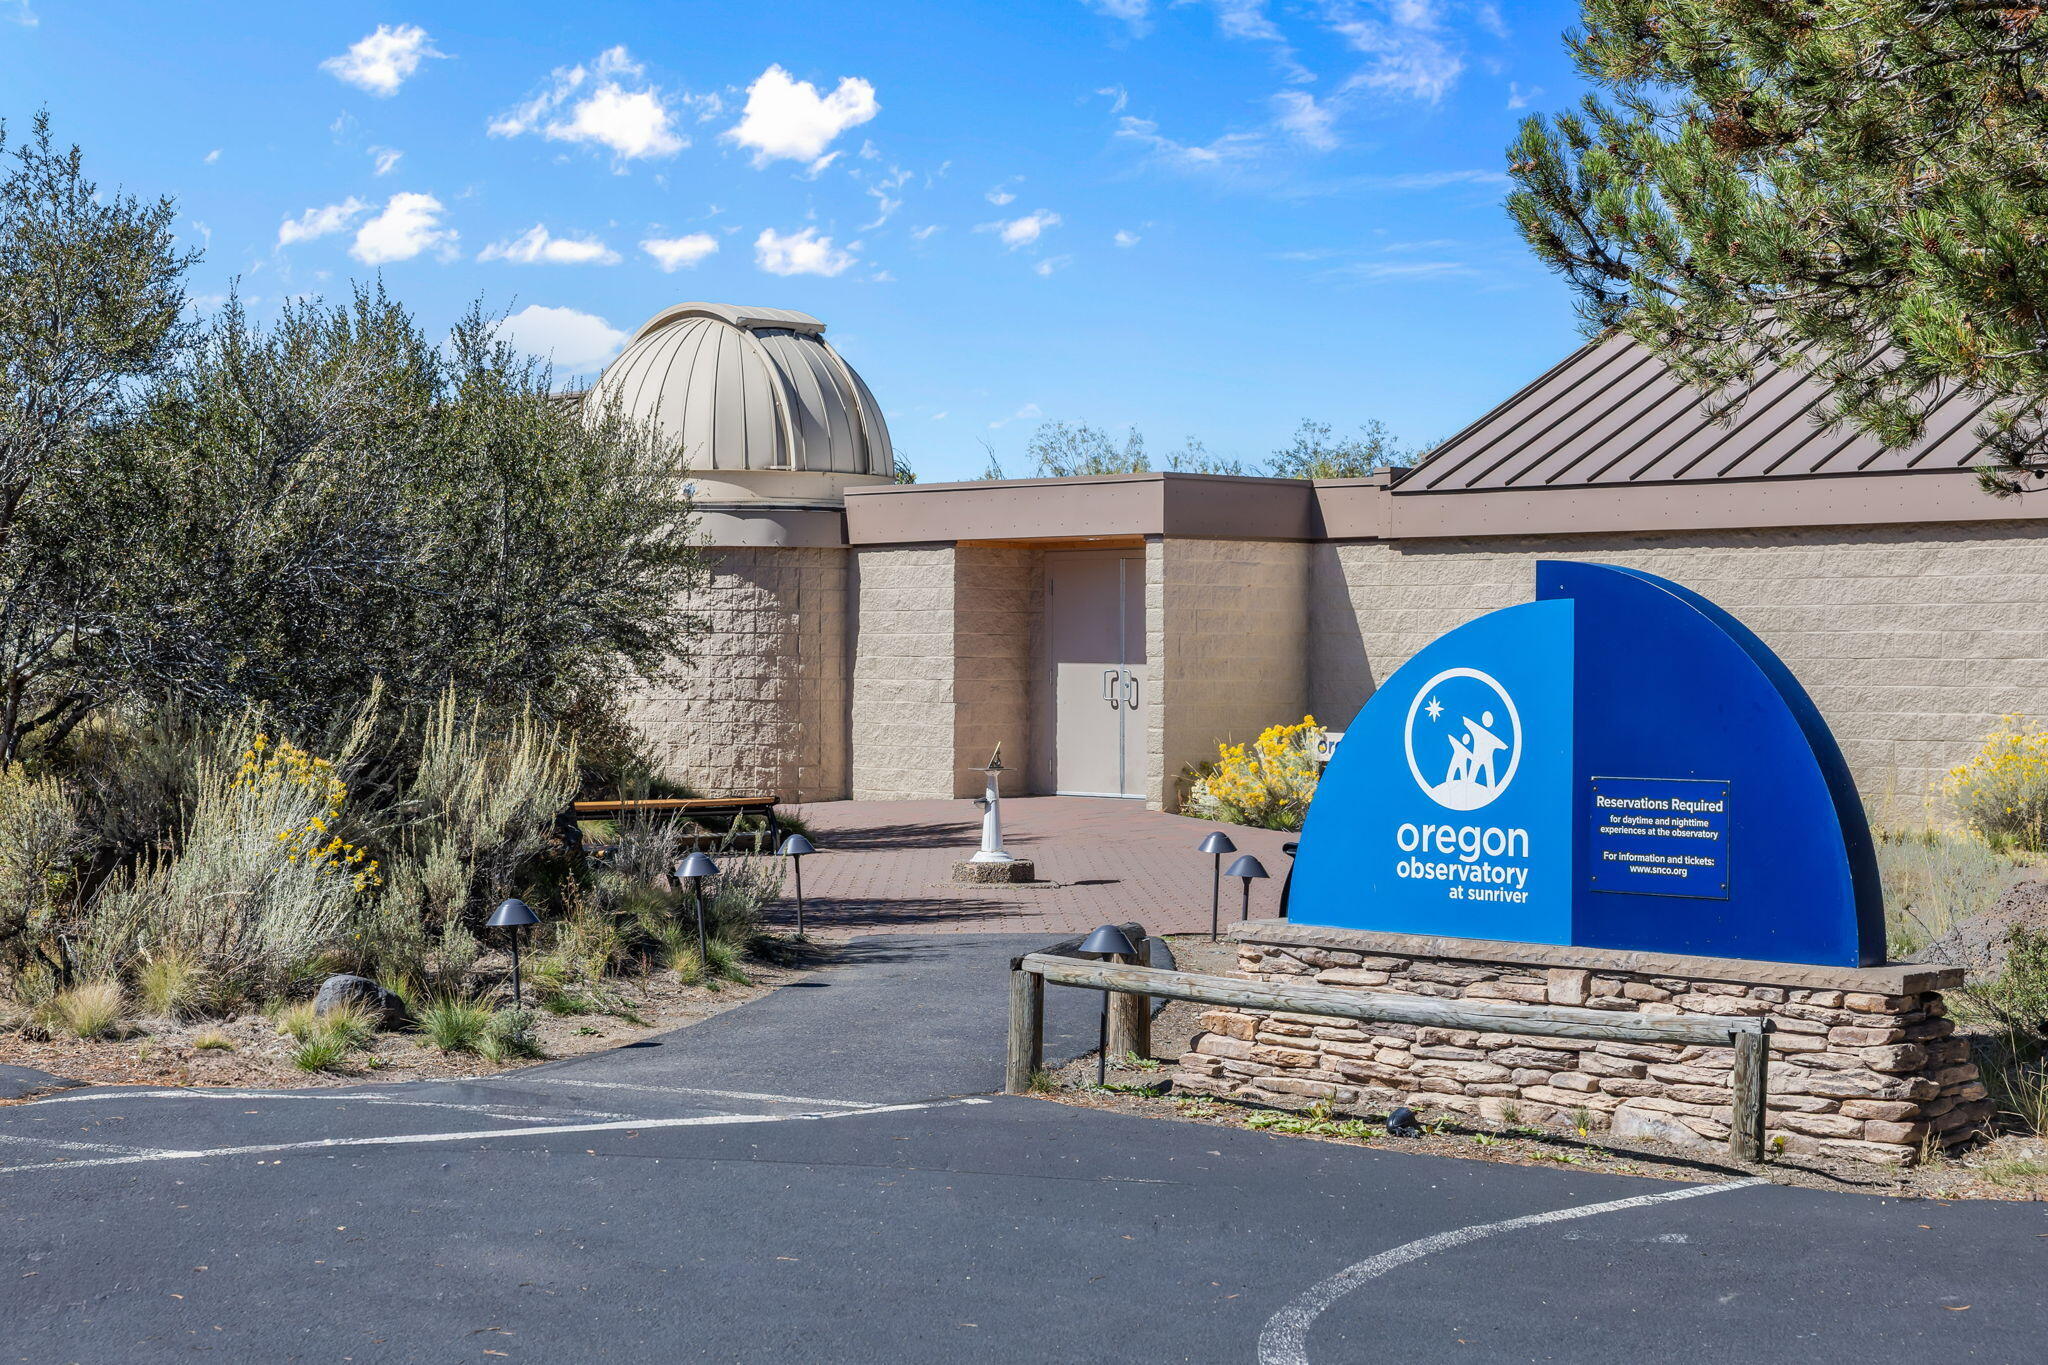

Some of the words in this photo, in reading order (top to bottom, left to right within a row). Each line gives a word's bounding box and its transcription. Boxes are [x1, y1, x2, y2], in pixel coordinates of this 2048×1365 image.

[1596, 795, 1669, 810] Reservations
[1671, 798, 1724, 813] Required
[1609, 814, 1622, 823] for
[1622, 815, 1654, 826] daytime
[1654, 817, 1670, 826] and
[1671, 818, 1709, 828] nighttime
[1600, 825, 1646, 836] experiences
[1647, 827, 1656, 836] at
[1657, 828, 1670, 836] the
[1671, 829, 1719, 840] observatory
[1396, 822, 1529, 863] oregon
[1603, 851, 1617, 861] For
[1618, 852, 1665, 863] information
[1667, 856, 1683, 864] and
[1684, 855, 1715, 866] tickets:
[1396, 856, 1529, 889] observatory
[1629, 864, 1688, 878] www.snco.org
[1449, 885, 1464, 899] at
[1467, 887, 1529, 904] sunriver
